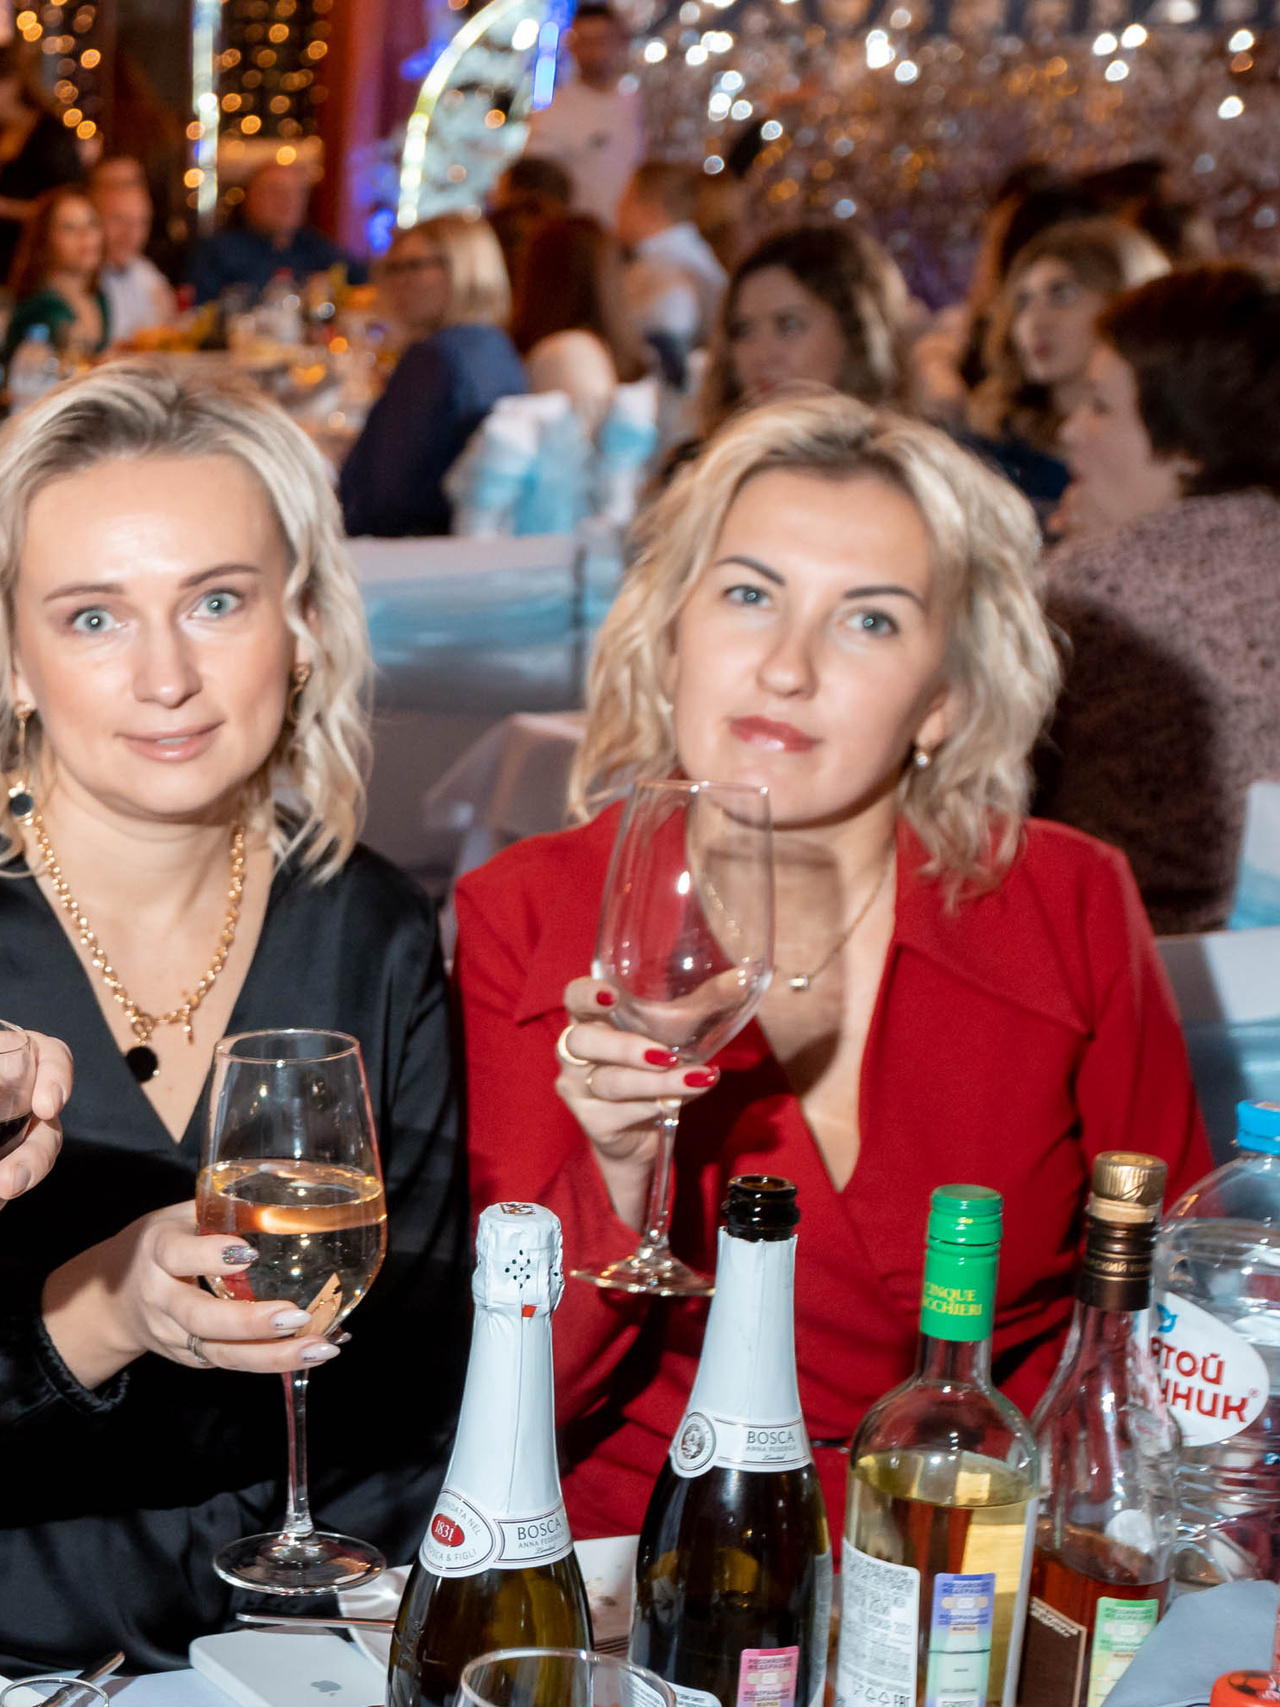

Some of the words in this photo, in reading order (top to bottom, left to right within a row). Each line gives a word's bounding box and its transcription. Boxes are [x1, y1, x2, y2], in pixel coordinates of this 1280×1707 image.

[746, 1430, 796, 1446] BOSCA
[434, 1520, 455, 1542] 1831
[516, 1517, 563, 1541] BOSCA
[518, 1540, 539, 1549] ANNA
[454, 1548, 477, 1561] FIGLI
